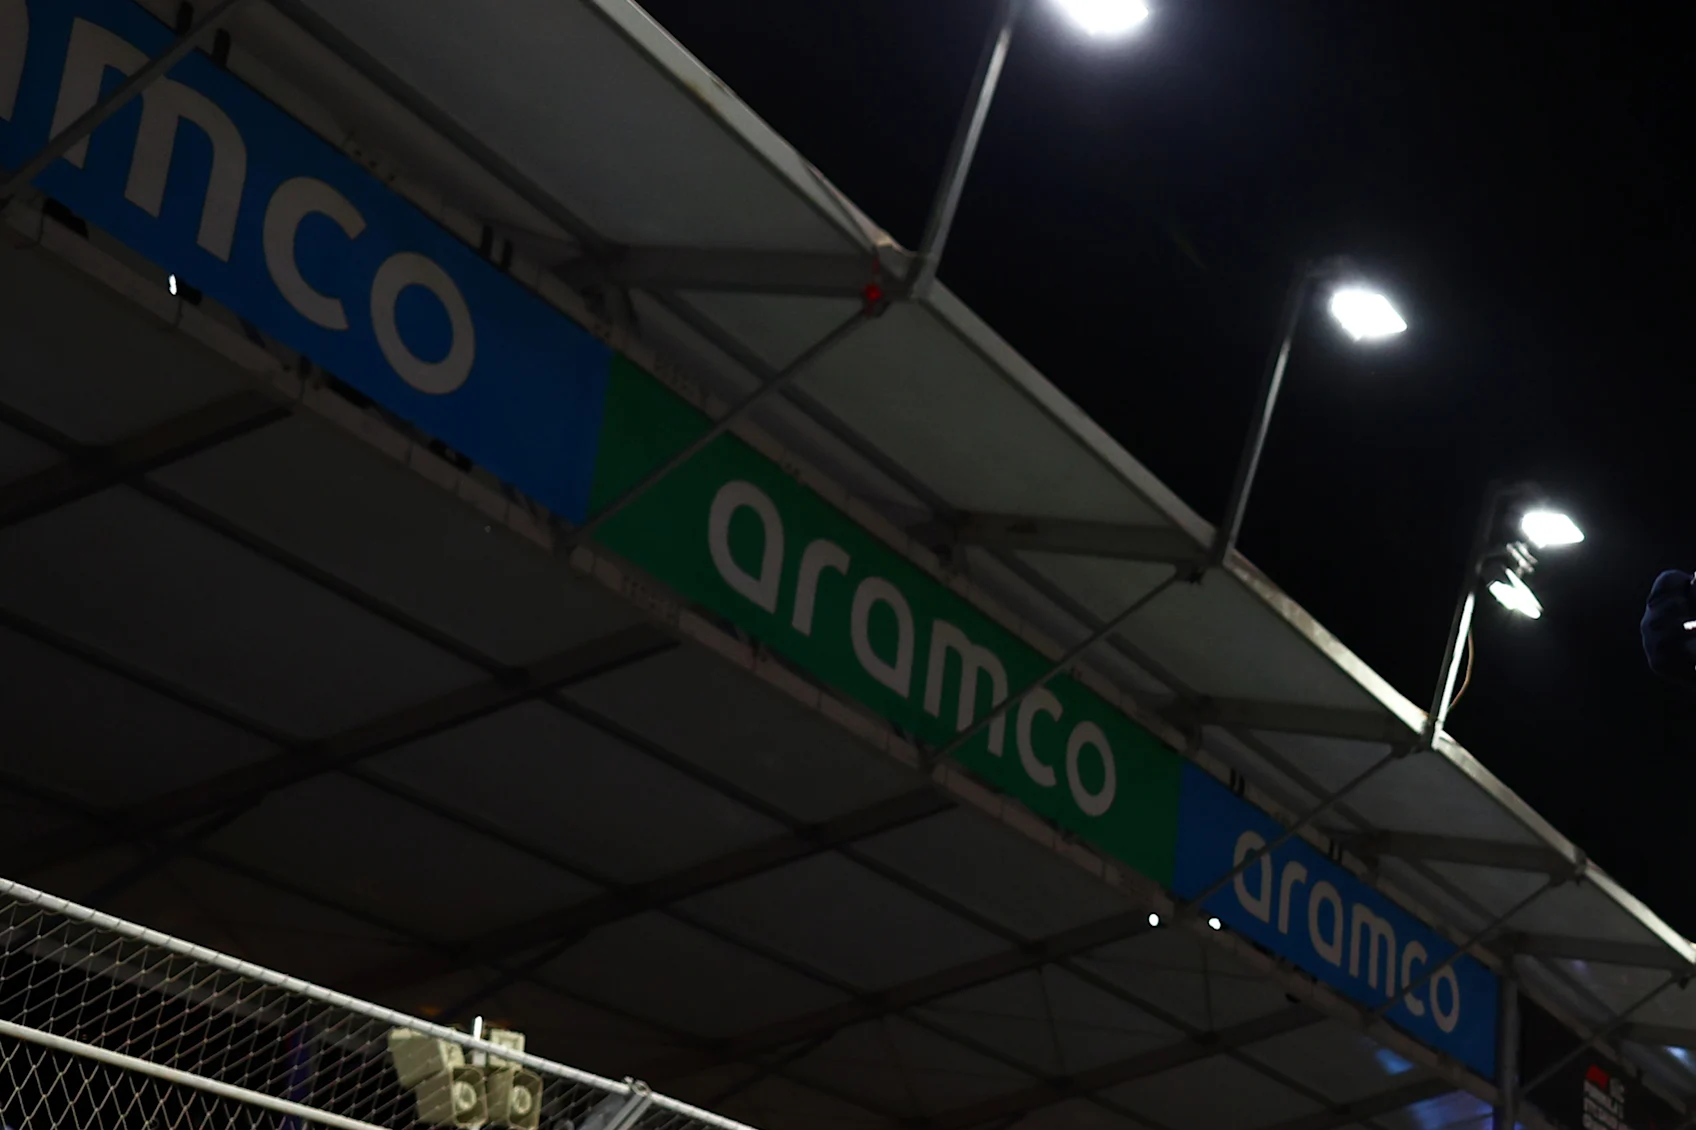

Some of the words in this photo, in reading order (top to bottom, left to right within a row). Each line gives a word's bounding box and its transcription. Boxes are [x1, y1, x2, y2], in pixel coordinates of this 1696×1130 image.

[0, 0, 476, 397] mco
[707, 479, 1117, 817] aramco
[1232, 829, 1460, 1034] aramco
